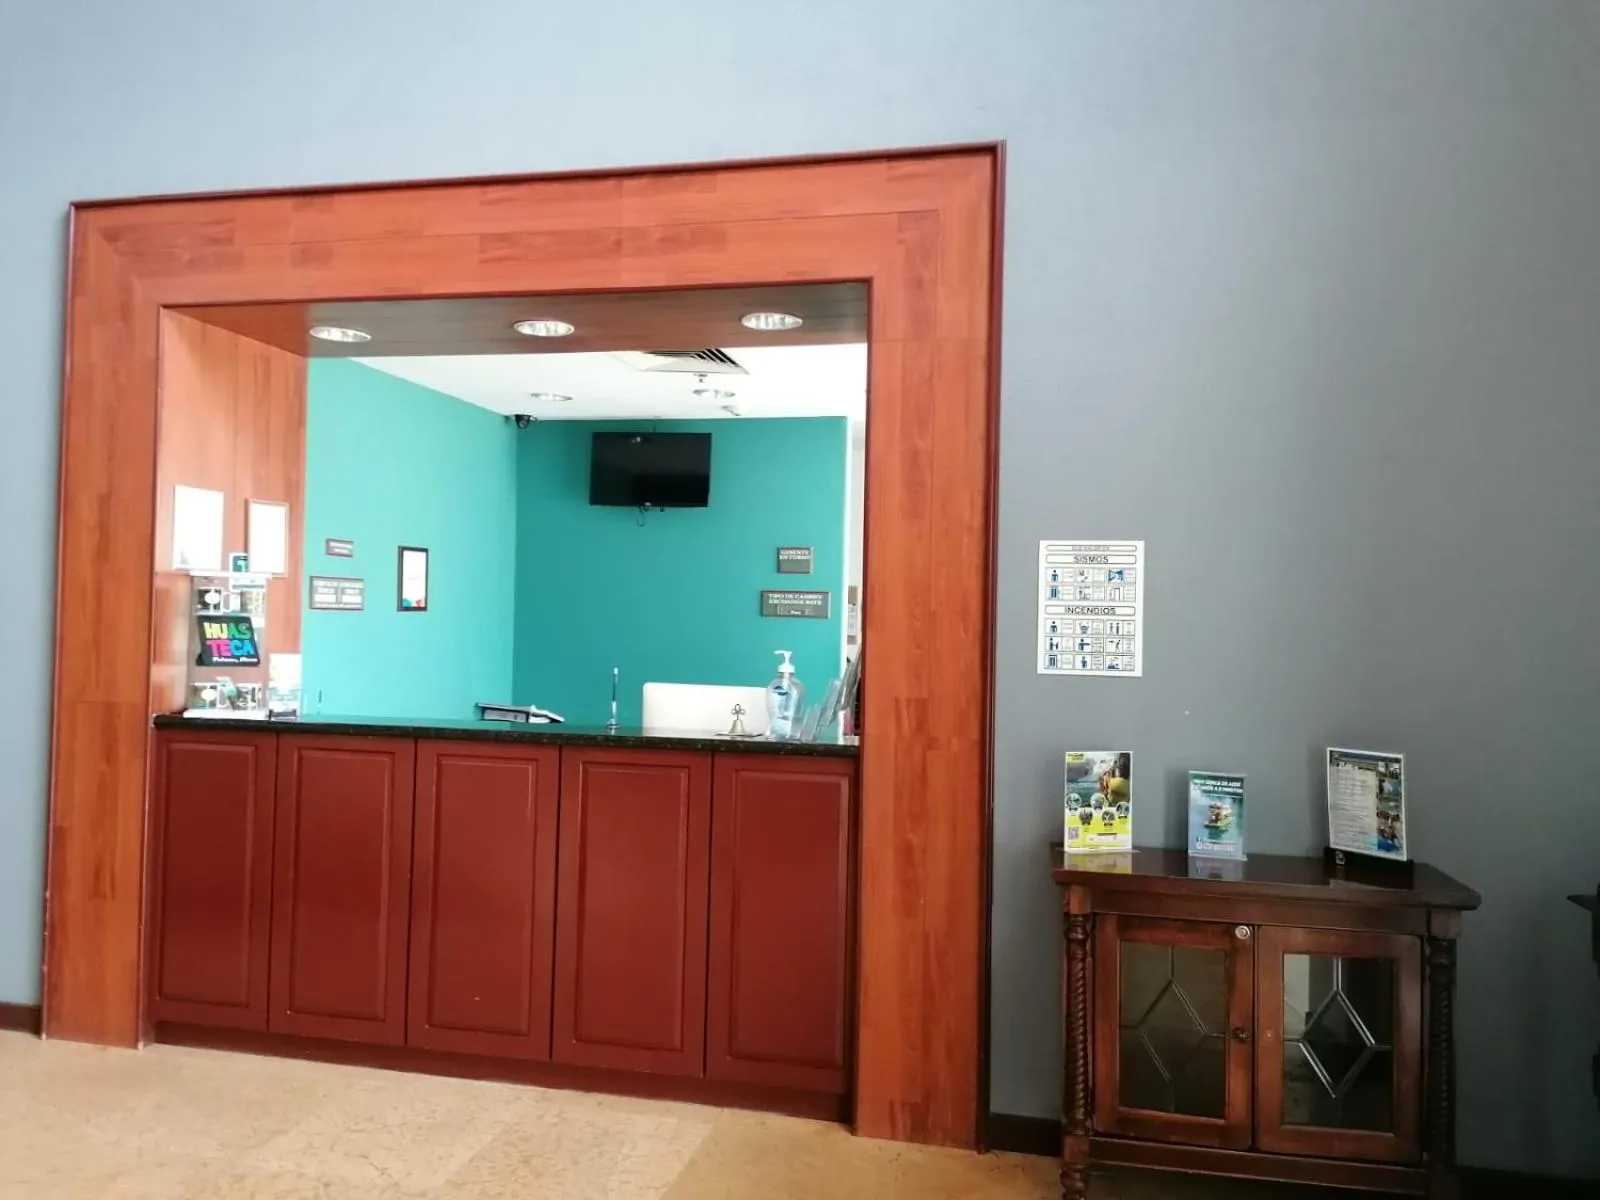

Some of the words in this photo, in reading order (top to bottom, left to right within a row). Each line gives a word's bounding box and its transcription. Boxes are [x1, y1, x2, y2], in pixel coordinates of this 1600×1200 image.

[1064, 607, 1116, 615] INCENDIOS
[203, 622, 251, 639] HUAS
[206, 639, 255, 656] TECA
